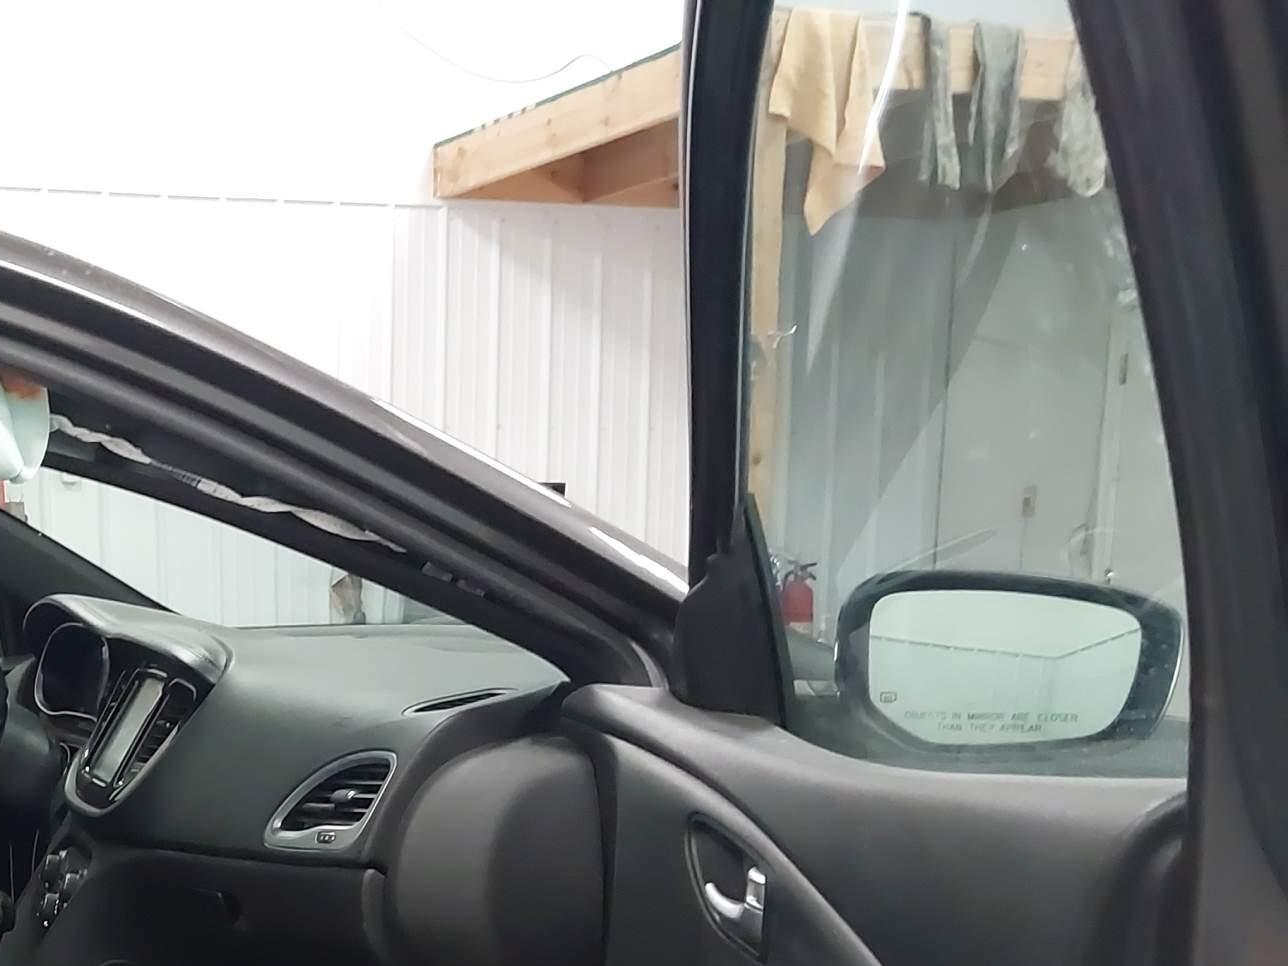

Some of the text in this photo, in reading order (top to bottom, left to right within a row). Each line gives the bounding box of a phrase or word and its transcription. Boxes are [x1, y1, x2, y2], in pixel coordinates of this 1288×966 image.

[951, 711, 962, 721] IN
[1010, 712, 1030, 721] ARE
[1037, 712, 1079, 723] CLOSER
